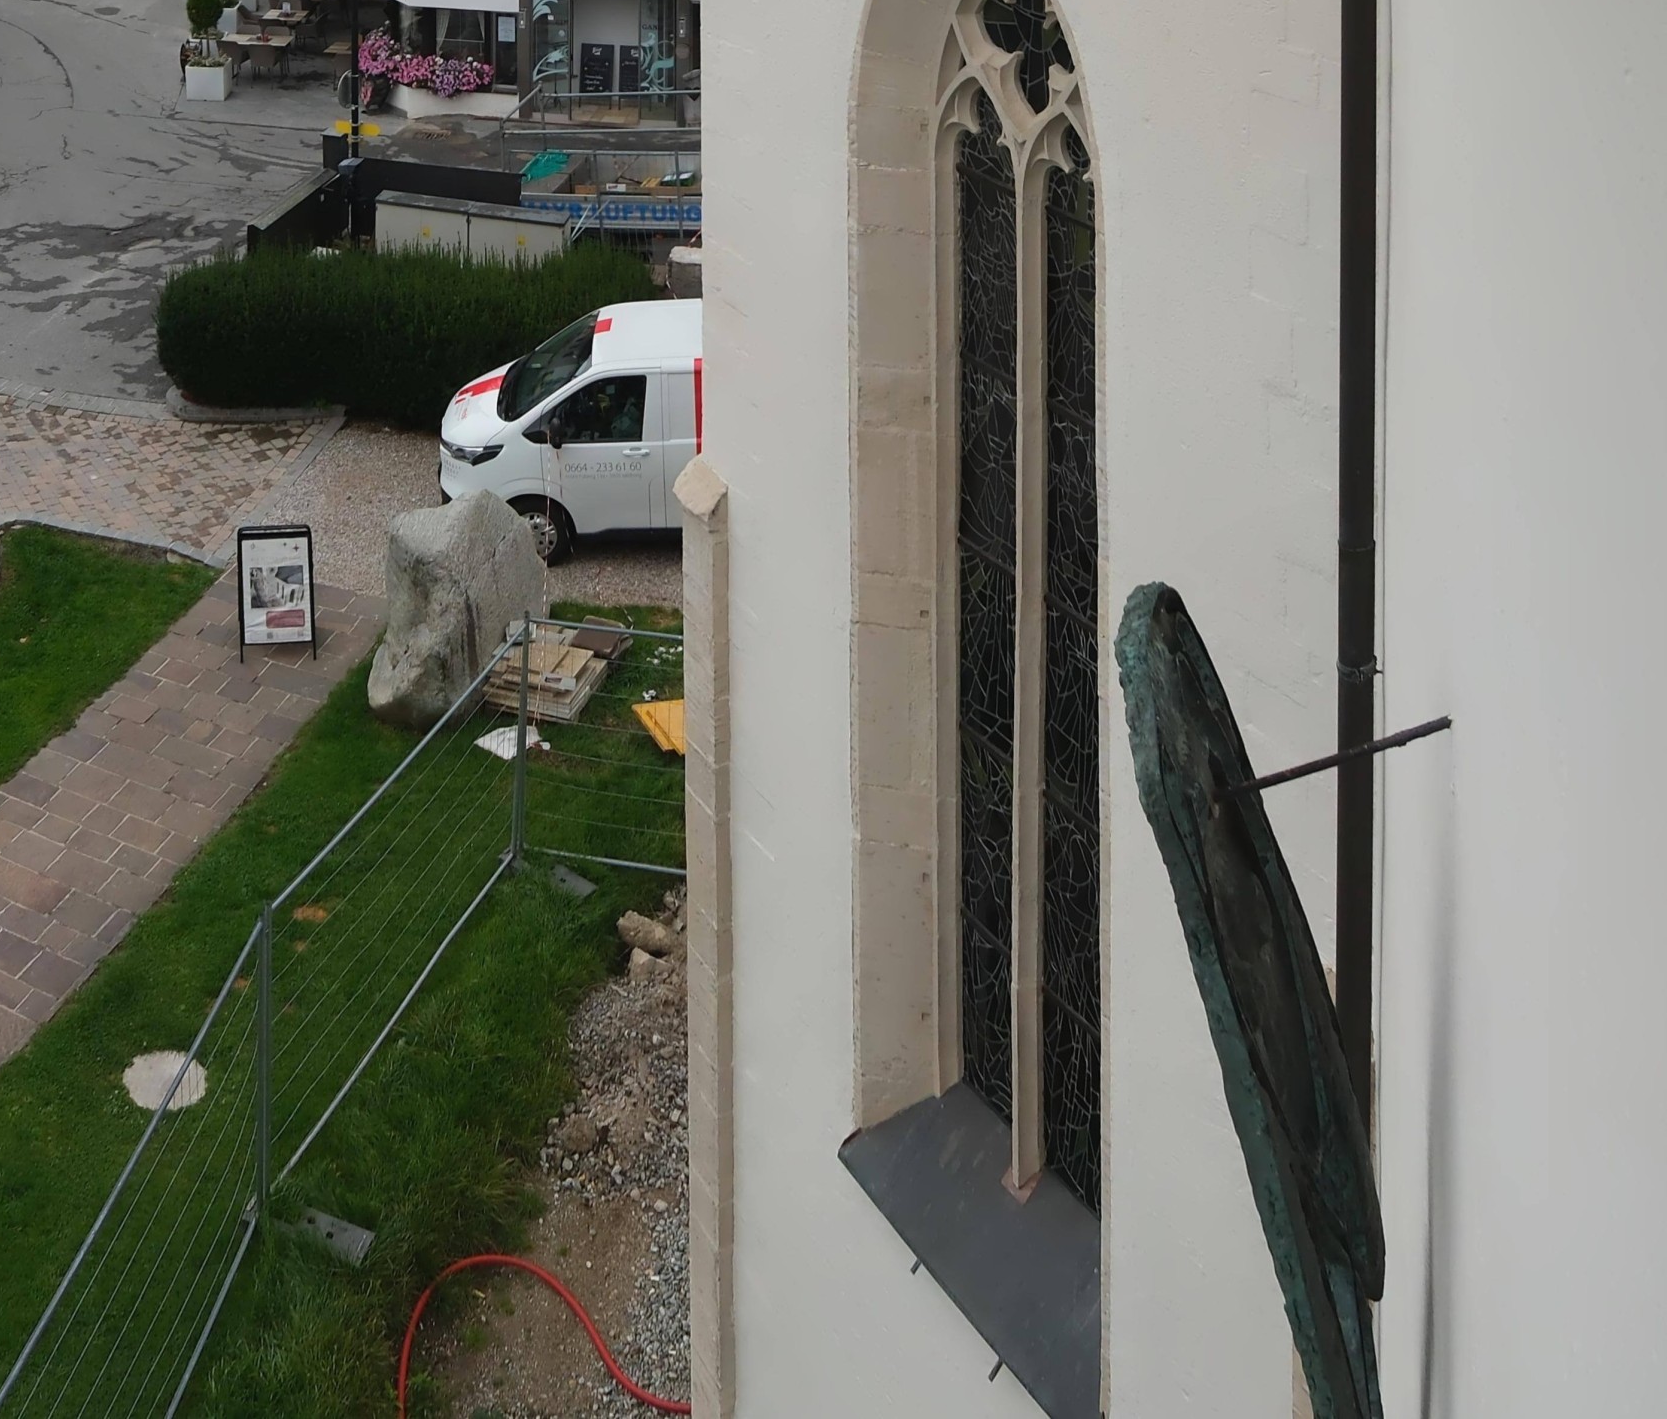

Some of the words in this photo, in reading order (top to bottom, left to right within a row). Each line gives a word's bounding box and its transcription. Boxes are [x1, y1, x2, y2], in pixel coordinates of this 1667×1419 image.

[564, 462, 587, 472] 0664
[596, 462, 613, 472] 233
[616, 462, 626, 472] 61
[629, 461, 642, 471] 60
